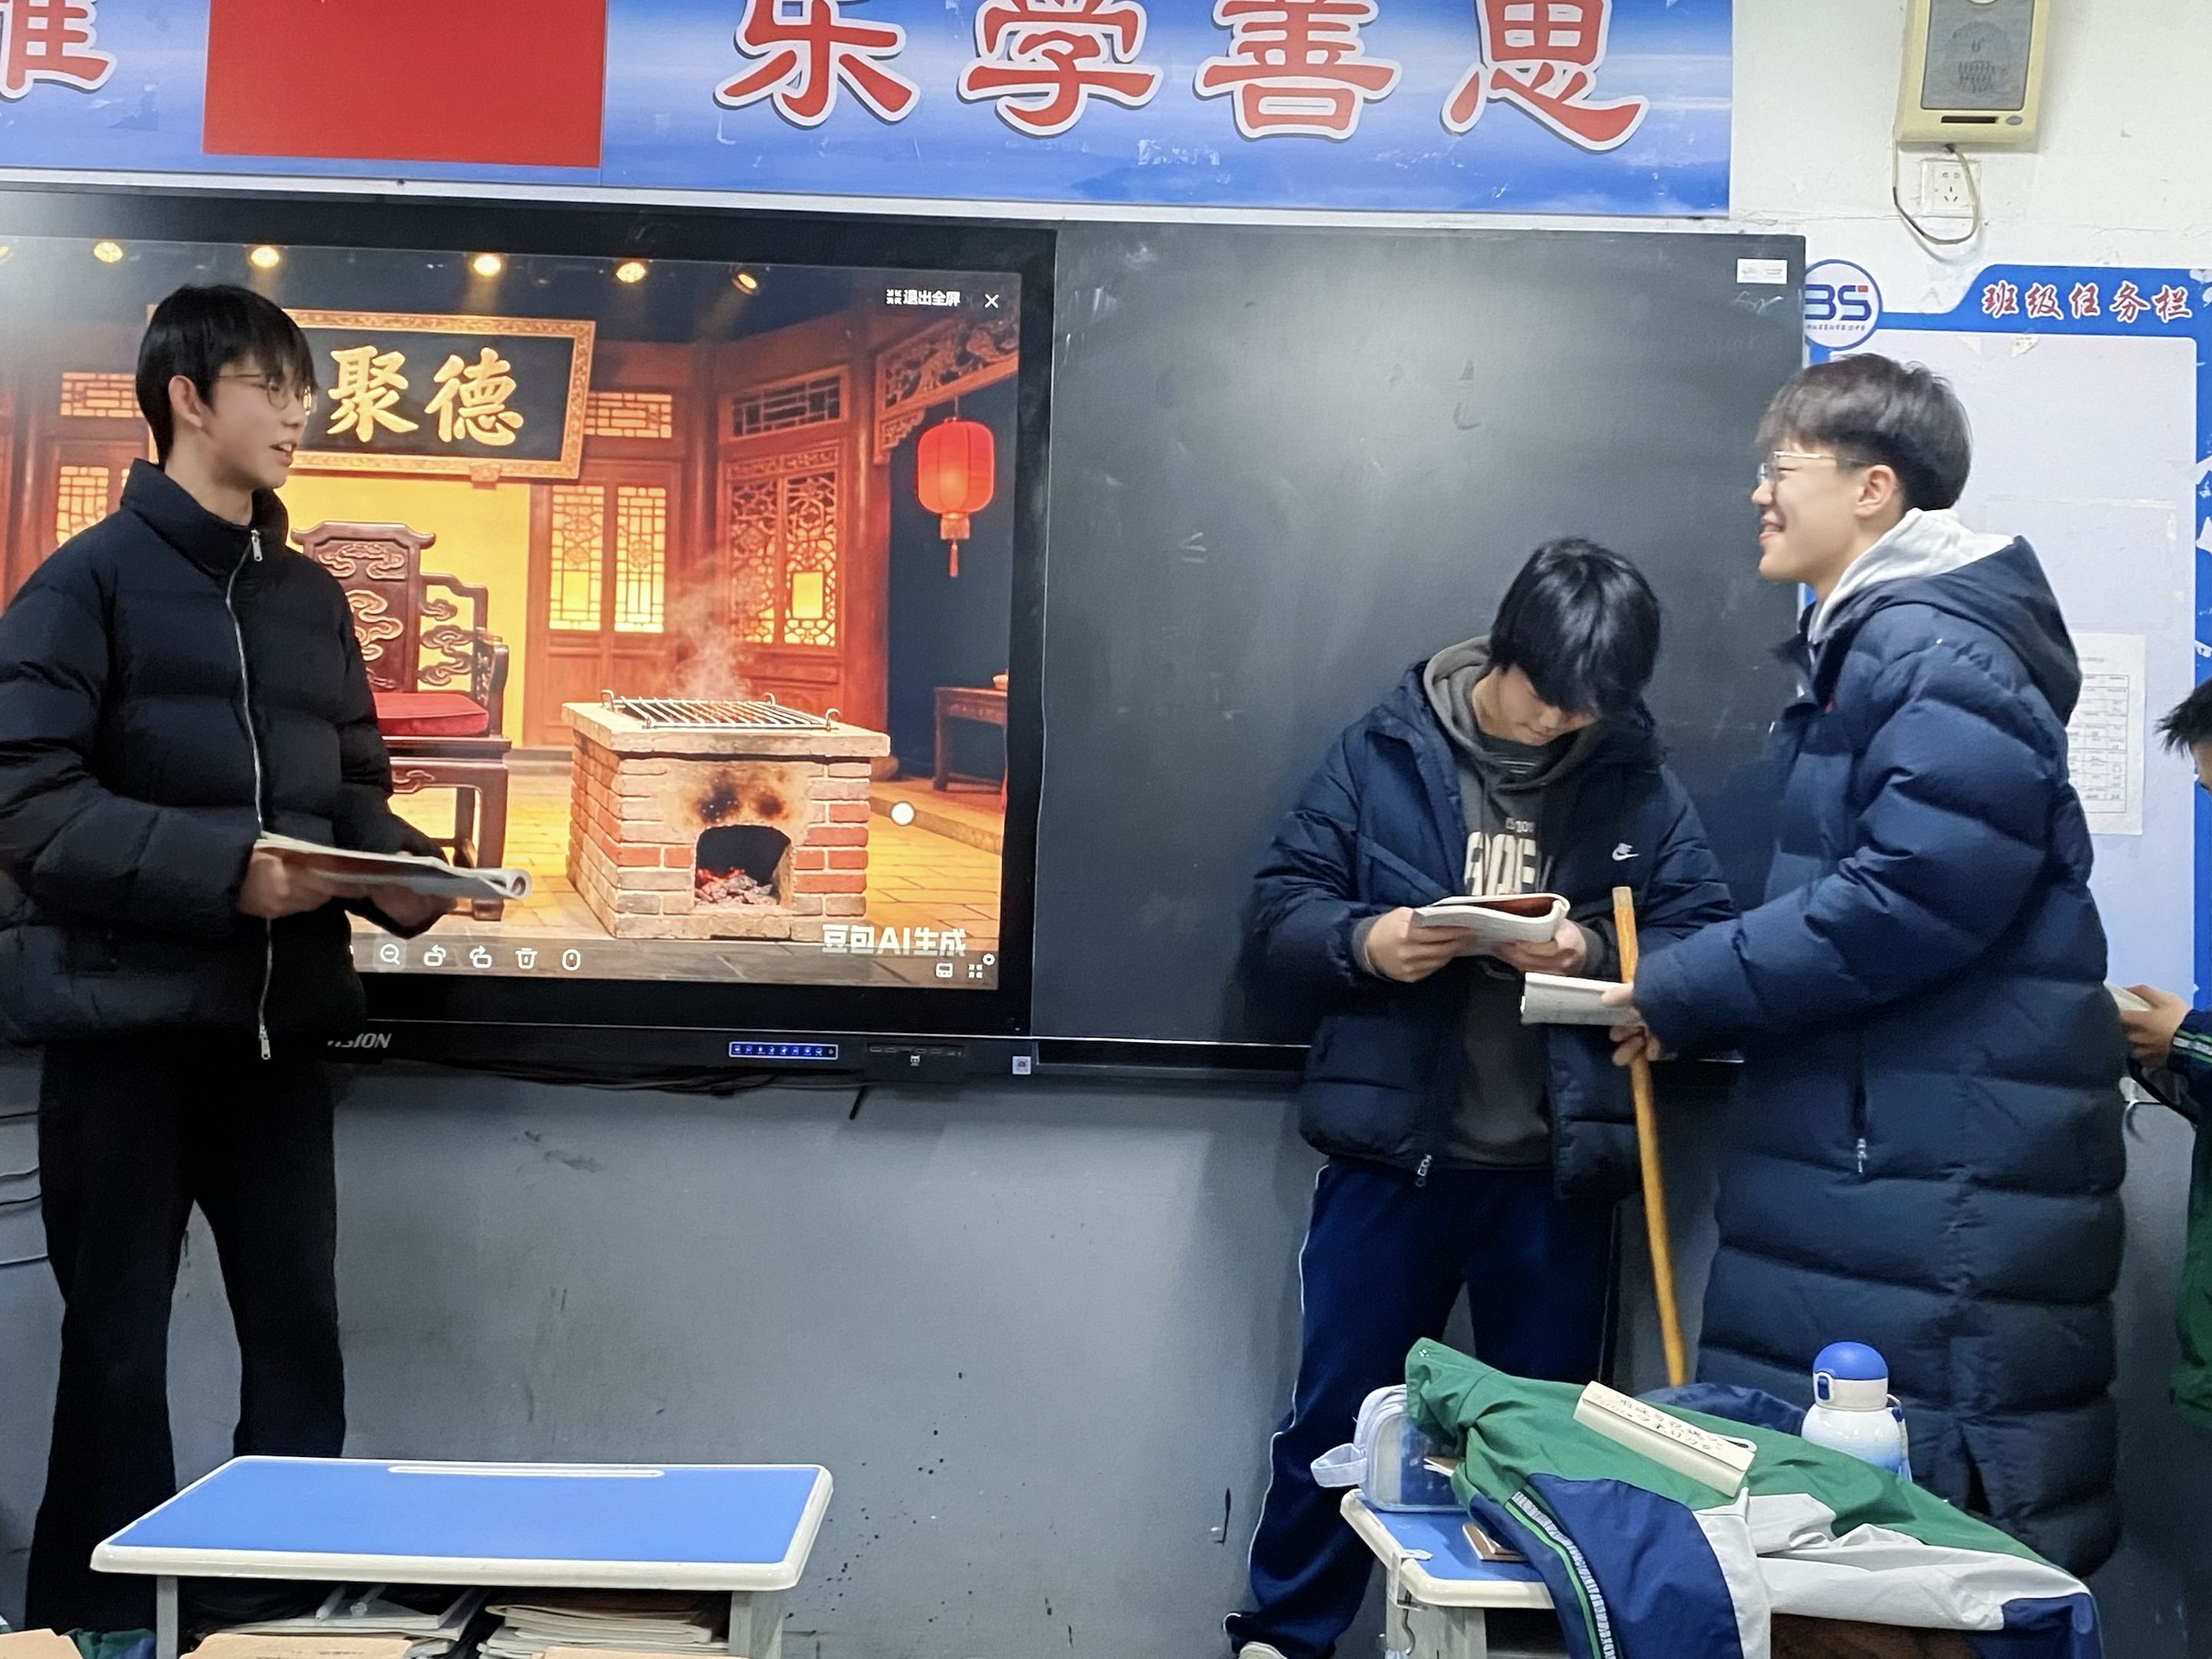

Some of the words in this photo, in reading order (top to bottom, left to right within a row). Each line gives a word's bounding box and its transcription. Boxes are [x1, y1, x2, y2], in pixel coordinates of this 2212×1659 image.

[903, 289, 961, 307] 退出全屏
[1982, 280, 2192, 323] 班级任务栏
[326, 345, 524, 446] 聚德
[822, 924, 967, 957] 豆包AI生成
